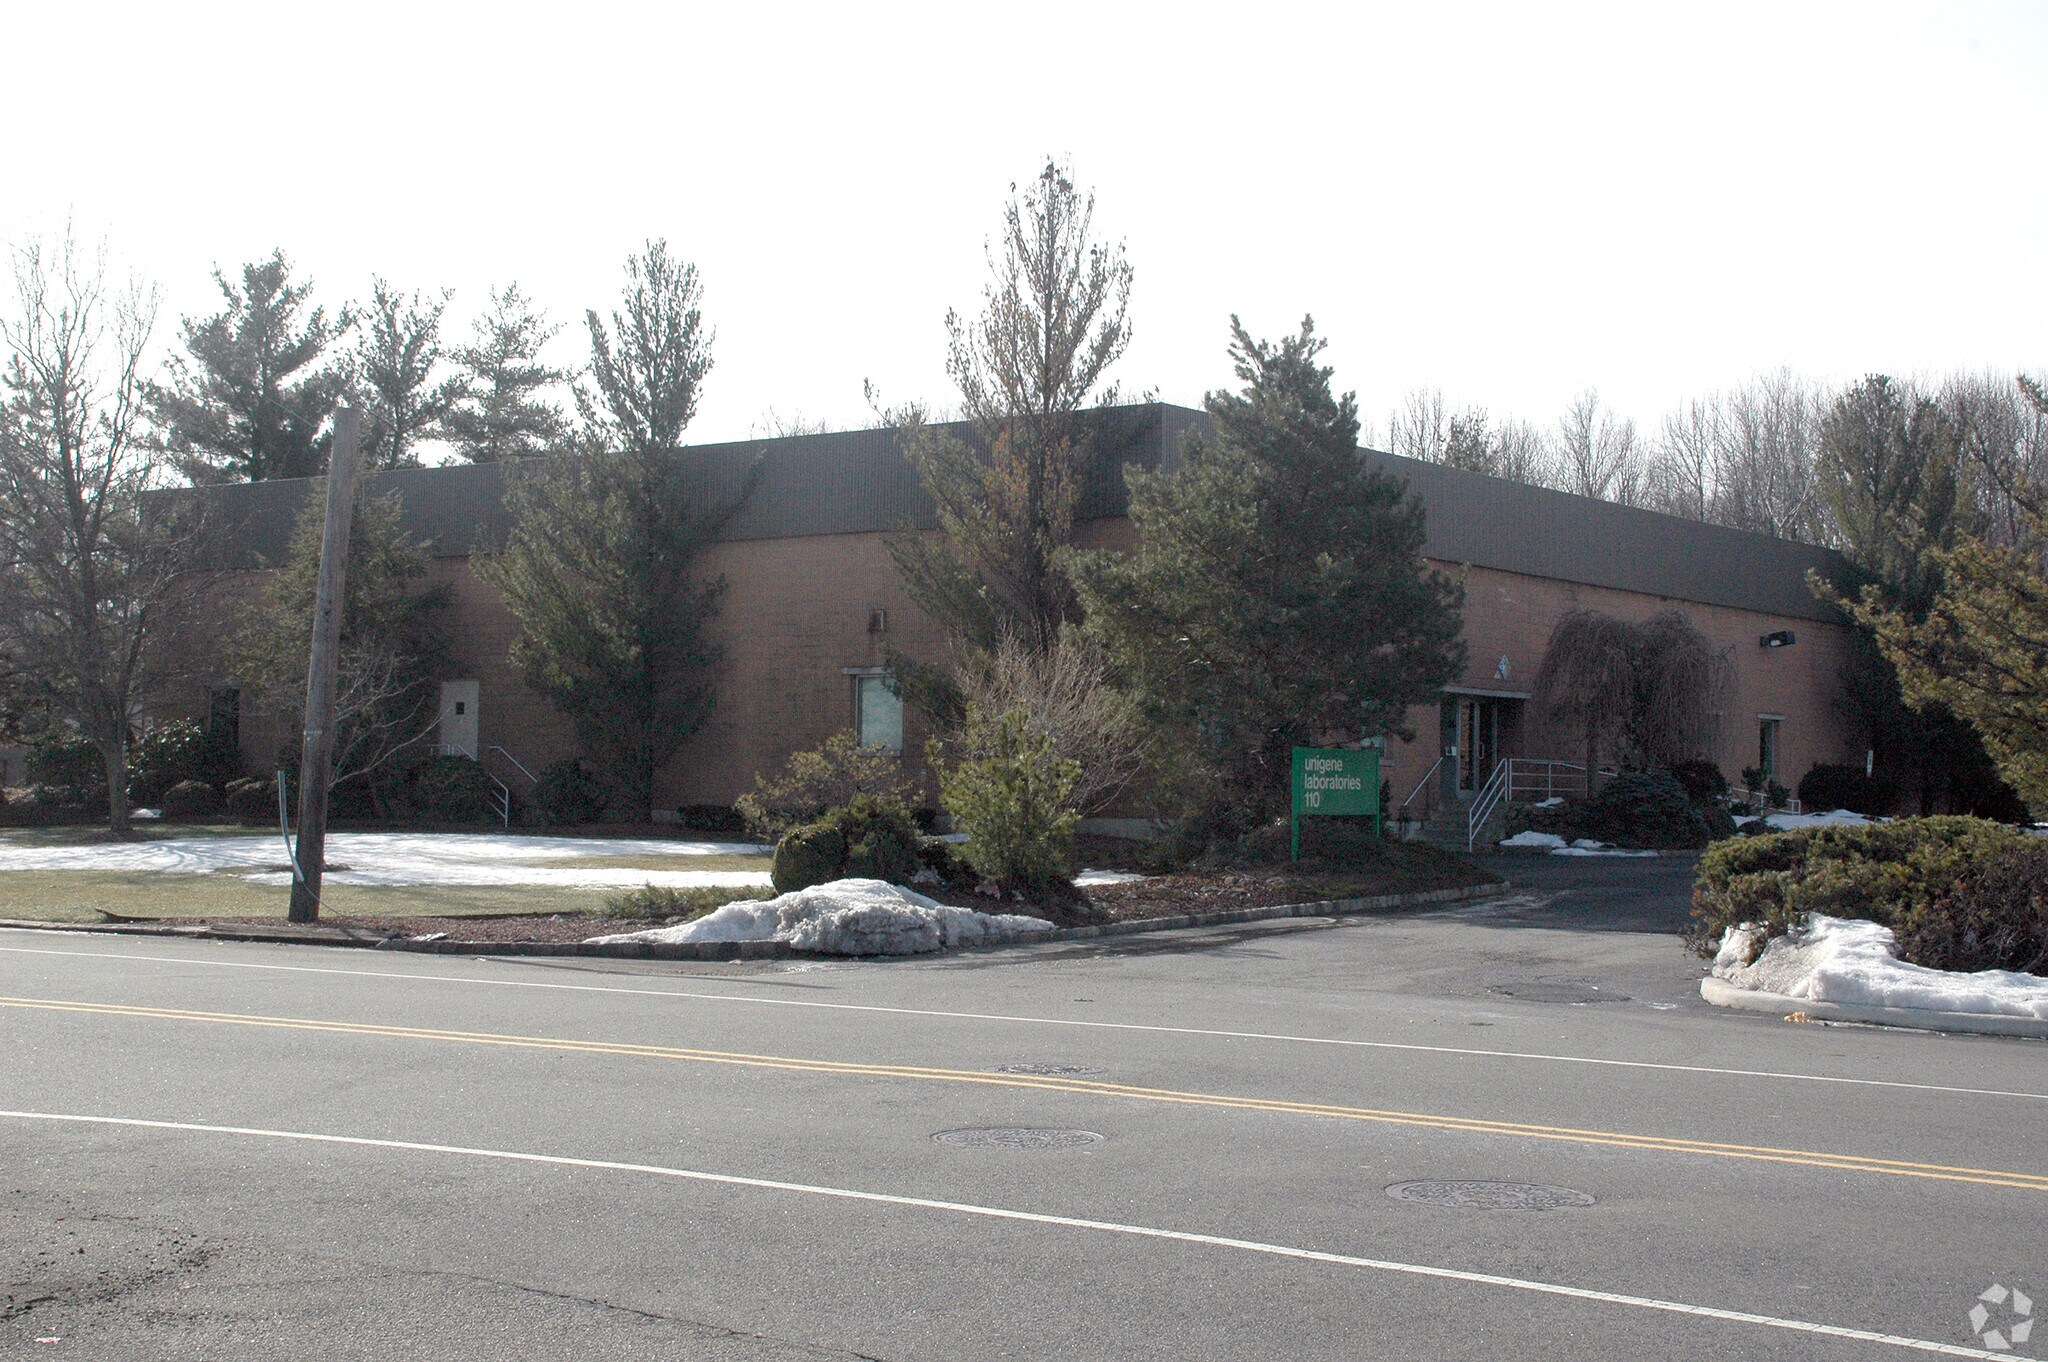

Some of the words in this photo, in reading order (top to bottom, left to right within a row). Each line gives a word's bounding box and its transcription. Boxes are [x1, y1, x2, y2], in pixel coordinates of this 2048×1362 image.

[1304, 755, 1343, 774] unigene
[1304, 773, 1361, 790] laboratories
[1304, 791, 1320, 808] 110
